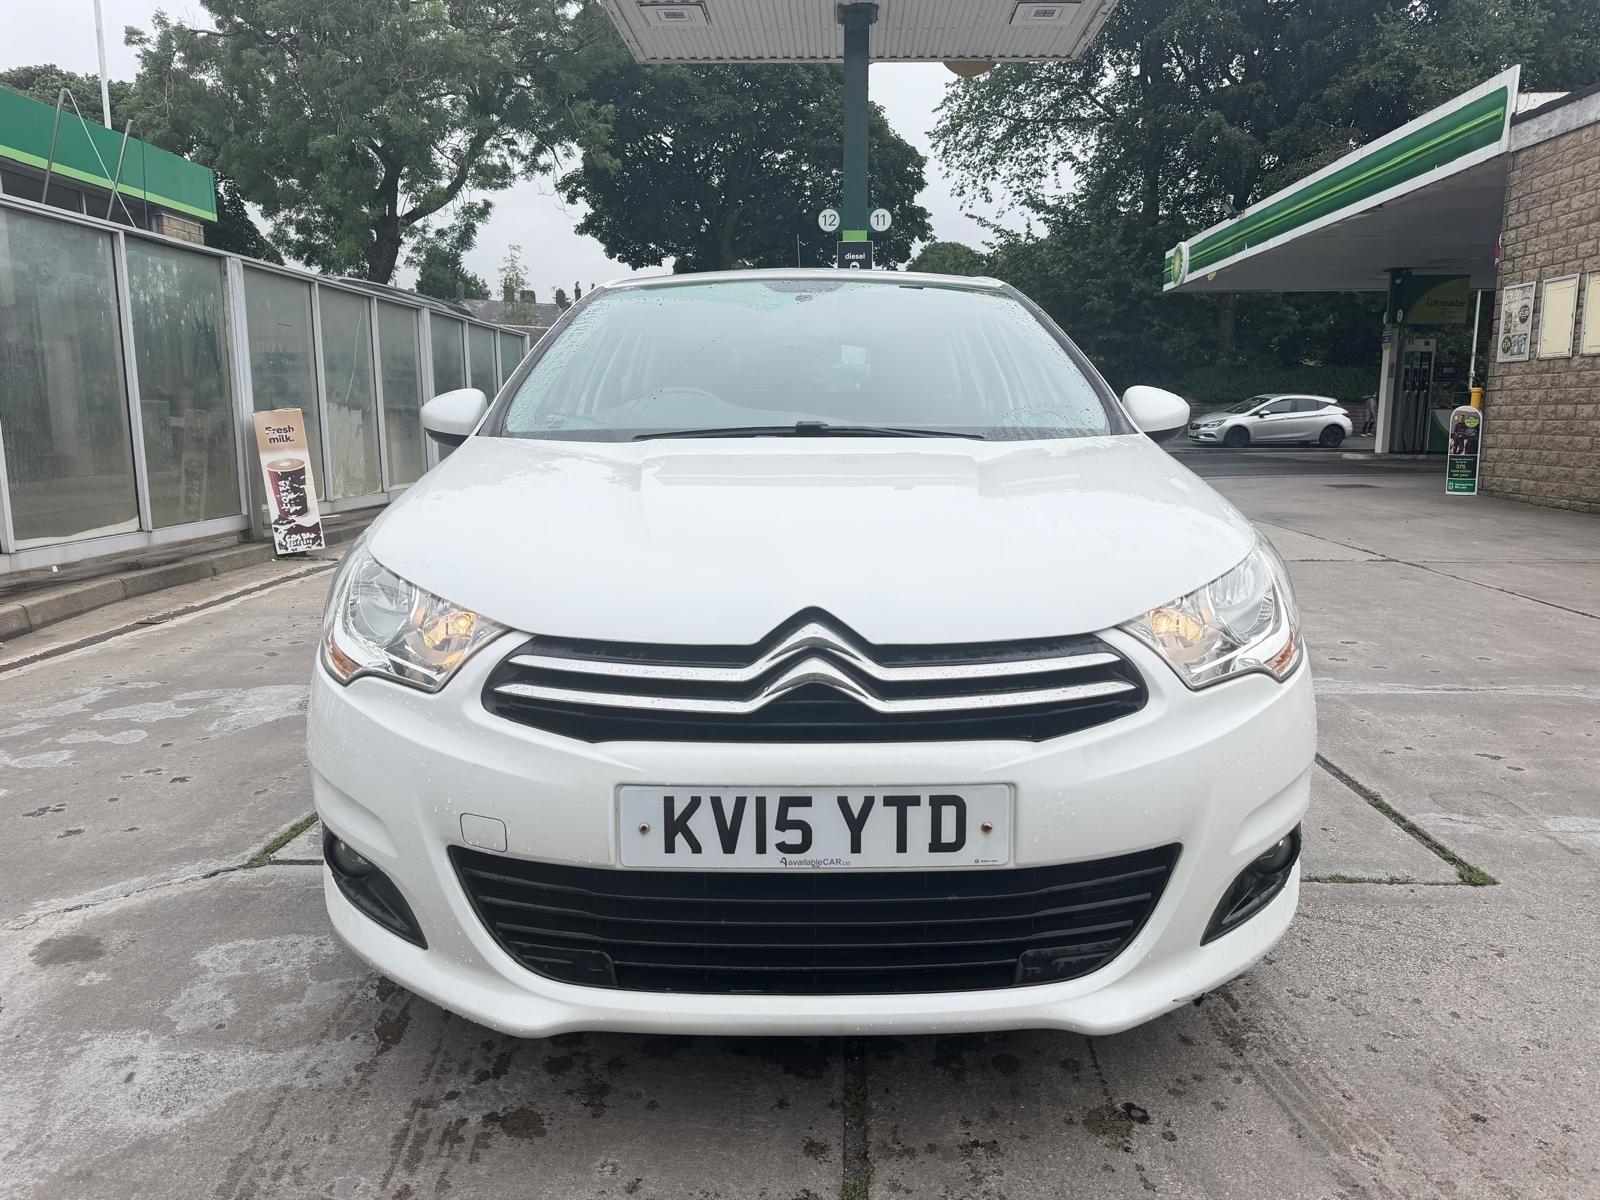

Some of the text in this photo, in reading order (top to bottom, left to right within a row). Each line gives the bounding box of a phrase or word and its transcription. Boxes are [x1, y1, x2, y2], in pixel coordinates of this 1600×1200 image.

[821, 213, 837, 227] 12
[874, 213, 886, 227] 11
[844, 252, 866, 260] diesel
[1425, 299, 1466, 308] ultimate
[265, 425, 295, 436] Fresh
[268, 435, 295, 445] milk.
[663, 794, 967, 854] KV15 YTD
